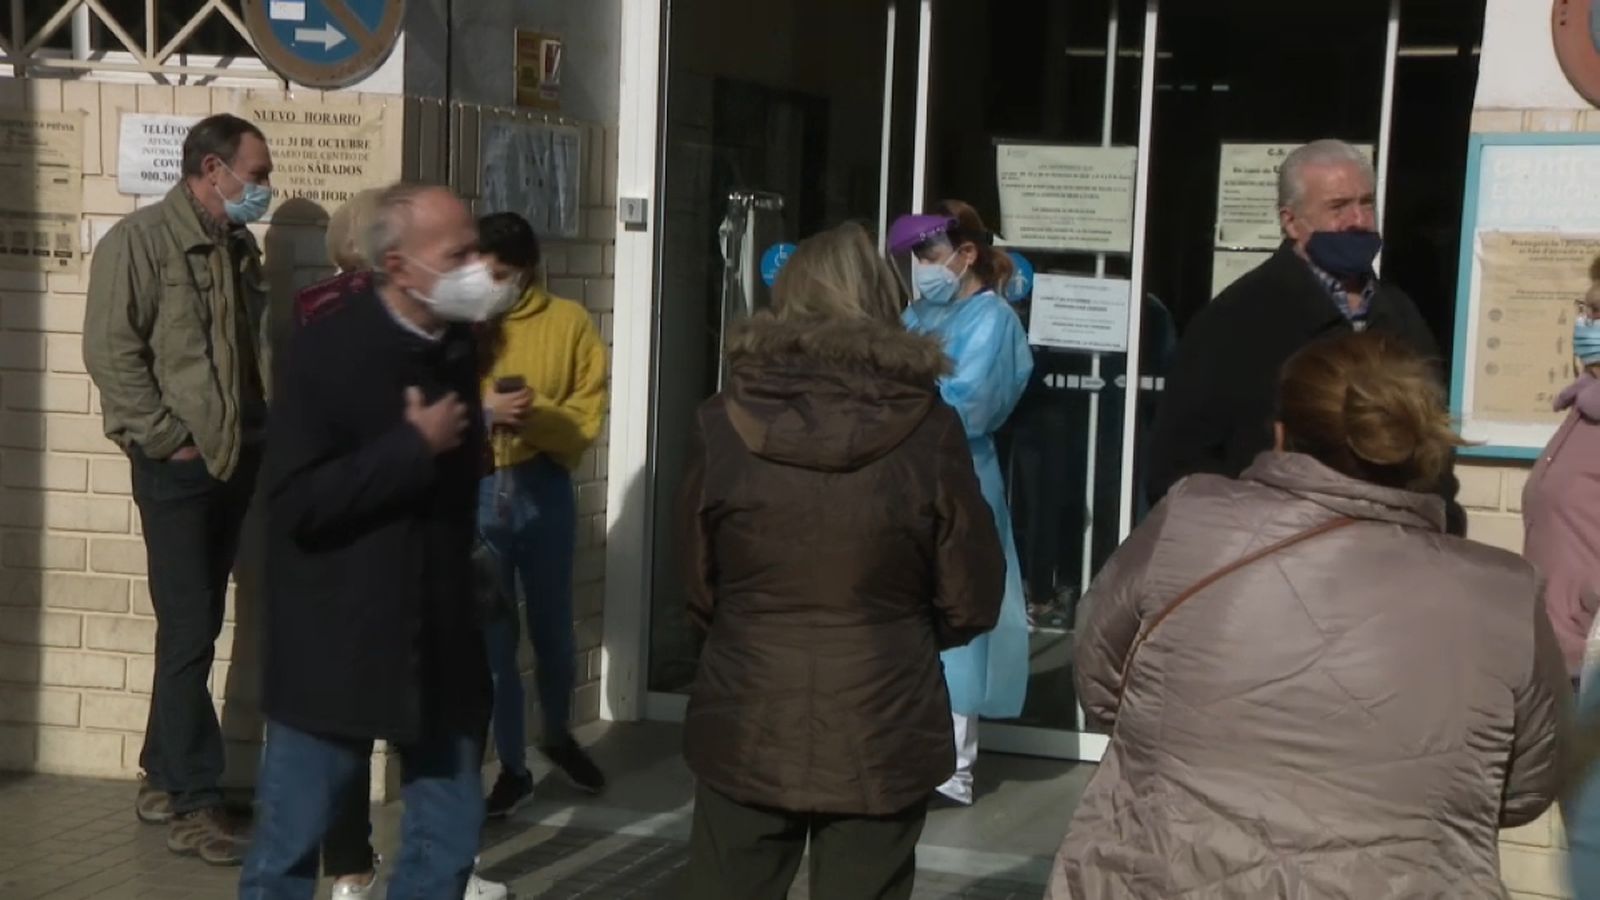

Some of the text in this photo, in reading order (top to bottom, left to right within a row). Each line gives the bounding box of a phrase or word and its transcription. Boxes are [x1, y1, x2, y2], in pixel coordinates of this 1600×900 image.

[253, 109, 361, 125] NUEVO HORARIO
[287, 136, 298, 147] 31
[300, 137, 313, 148] DE
[317, 138, 370, 150] OCTUBRE
[307, 160, 363, 176] SÁBADOS
